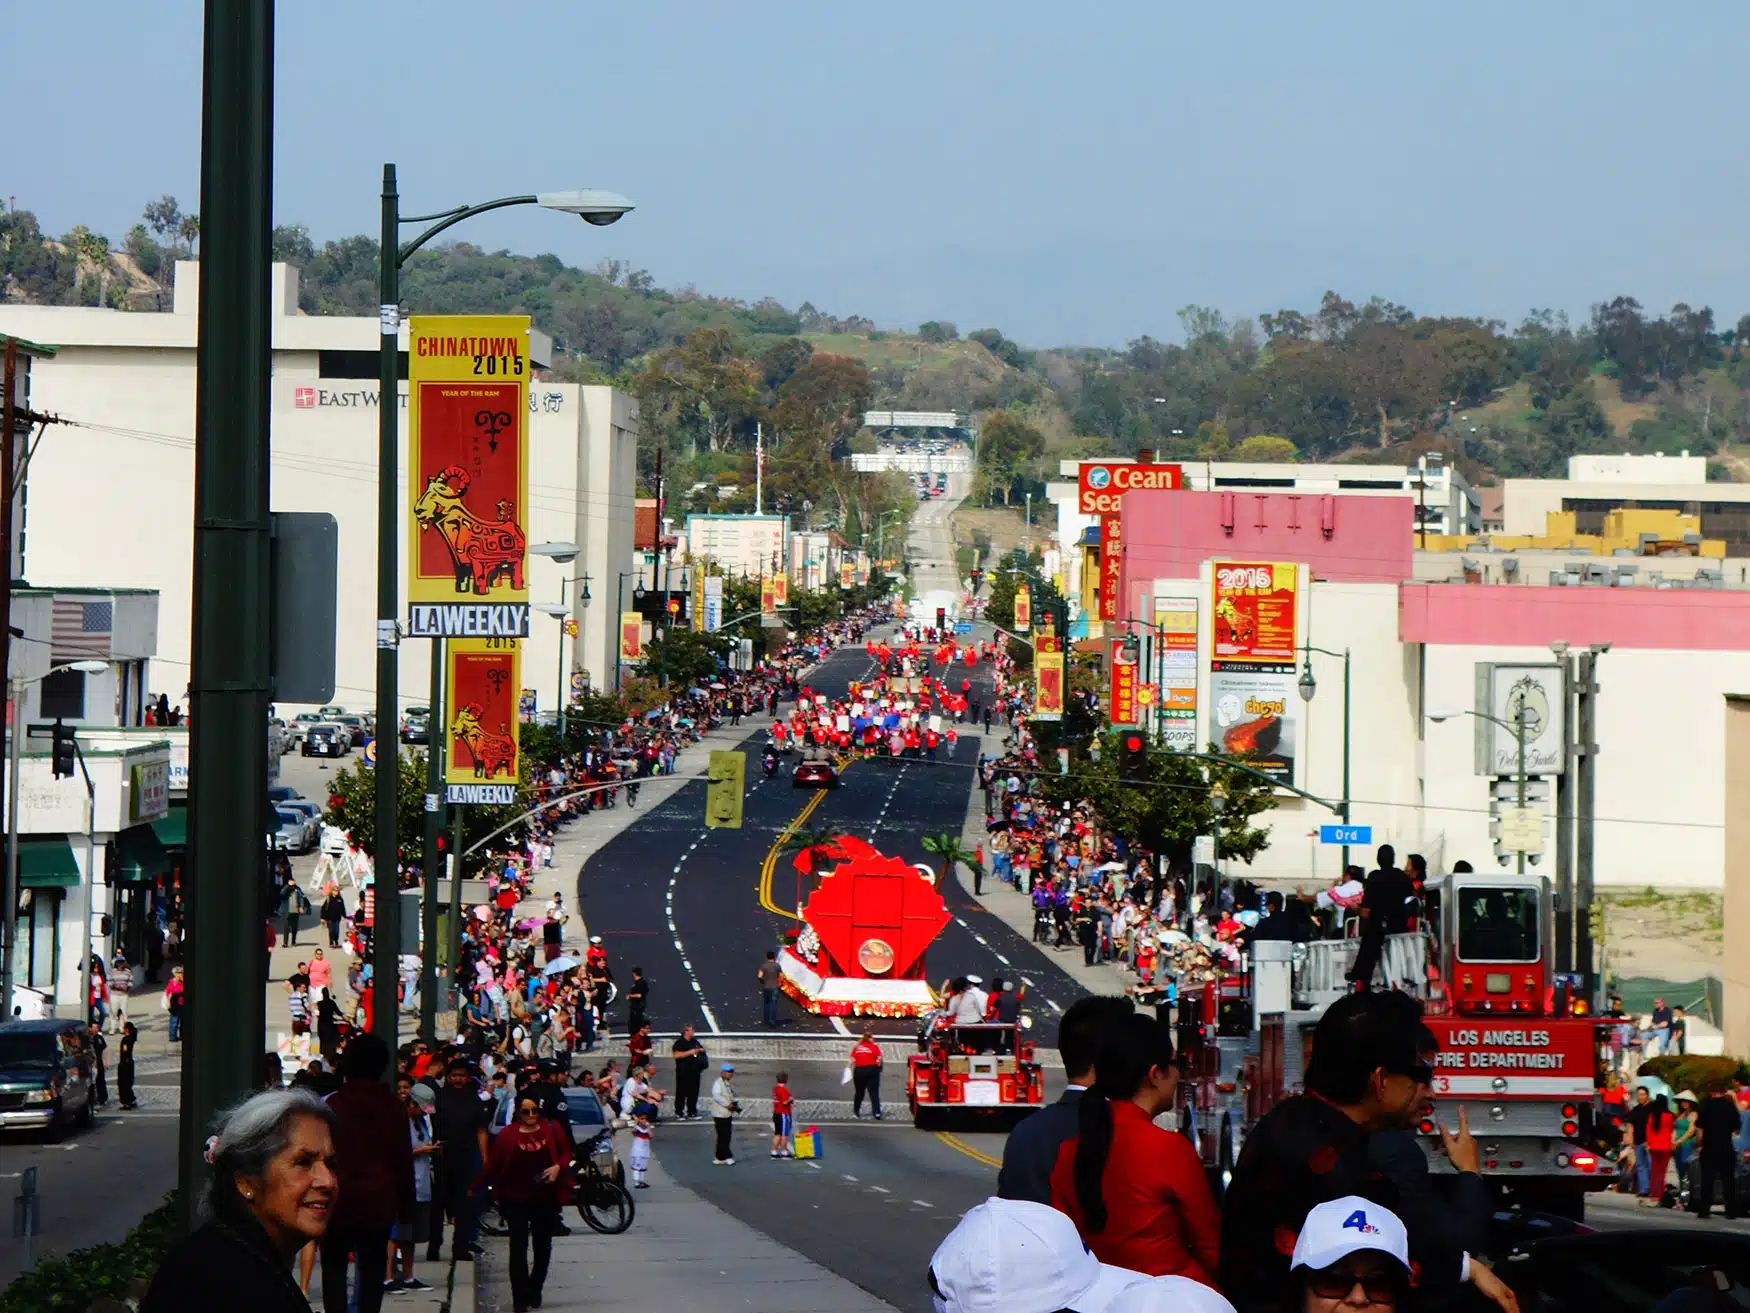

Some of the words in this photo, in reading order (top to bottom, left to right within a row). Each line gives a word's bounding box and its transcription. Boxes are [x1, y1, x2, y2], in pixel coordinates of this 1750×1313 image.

[417, 337, 518, 357] CHINATOWN
[473, 355, 523, 375] 2015
[1217, 567, 1271, 589] 2015
[486, 638, 516, 649] 2015
[1335, 828, 1358, 840] Ord
[1450, 1030, 1479, 1046] LOS
[1482, 1030, 1550, 1047] ANGELES
[1434, 1052, 1466, 1068] FIRE
[1469, 1052, 1565, 1069] DEPARTMENT
[1342, 1210, 1368, 1233] 4
